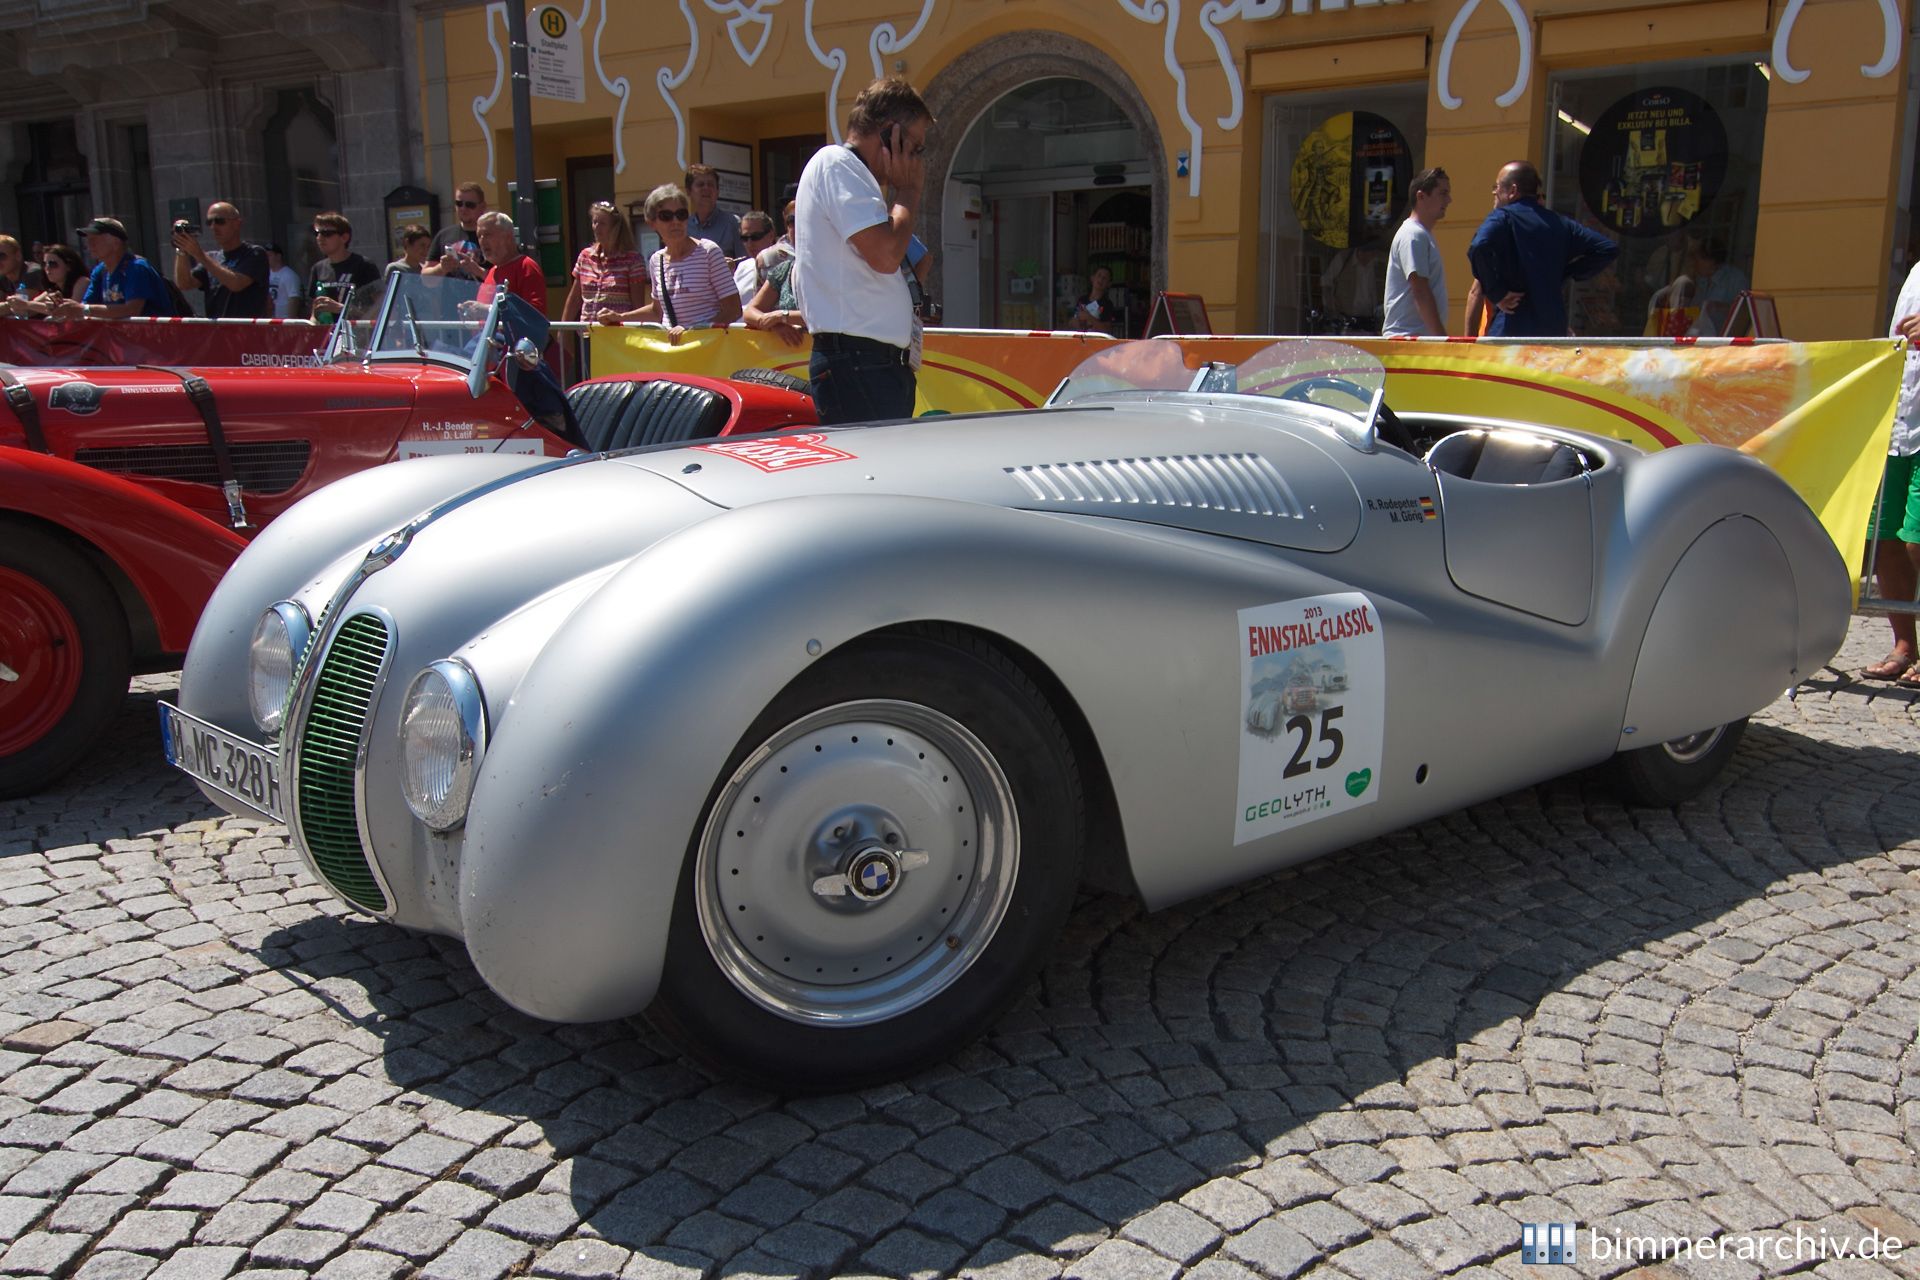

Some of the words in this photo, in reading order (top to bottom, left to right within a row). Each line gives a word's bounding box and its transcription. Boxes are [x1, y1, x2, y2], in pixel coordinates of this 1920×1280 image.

[1627, 111, 1648, 120] JETZT
[1650, 109, 1666, 118] NEU
[1667, 108, 1684, 117] UND
[1617, 119, 1653, 130] EXKLUSIV
[1655, 119, 1667, 128] BEI
[121, 386, 177, 394] ENNSTAL-CLASSIC
[422, 422, 444, 430] H.-J.
[445, 422, 474, 430] Bender
[443, 431, 453, 439] D.
[454, 431, 473, 439] Latif
[464, 446, 484, 454] 2013
[1366, 499, 1377, 510] R.
[1377, 498, 1418, 510] Rodepeter
[1390, 511, 1401, 523] M.
[1304, 606, 1323, 620] 2013
[1248, 604, 1374, 658] ENNSTAL-CLASSIC
[169, 713, 186, 763] M
[191, 725, 221, 781] MC
[1283, 705, 1344, 780] 25
[1245, 785, 1326, 822] GEOLYTH
